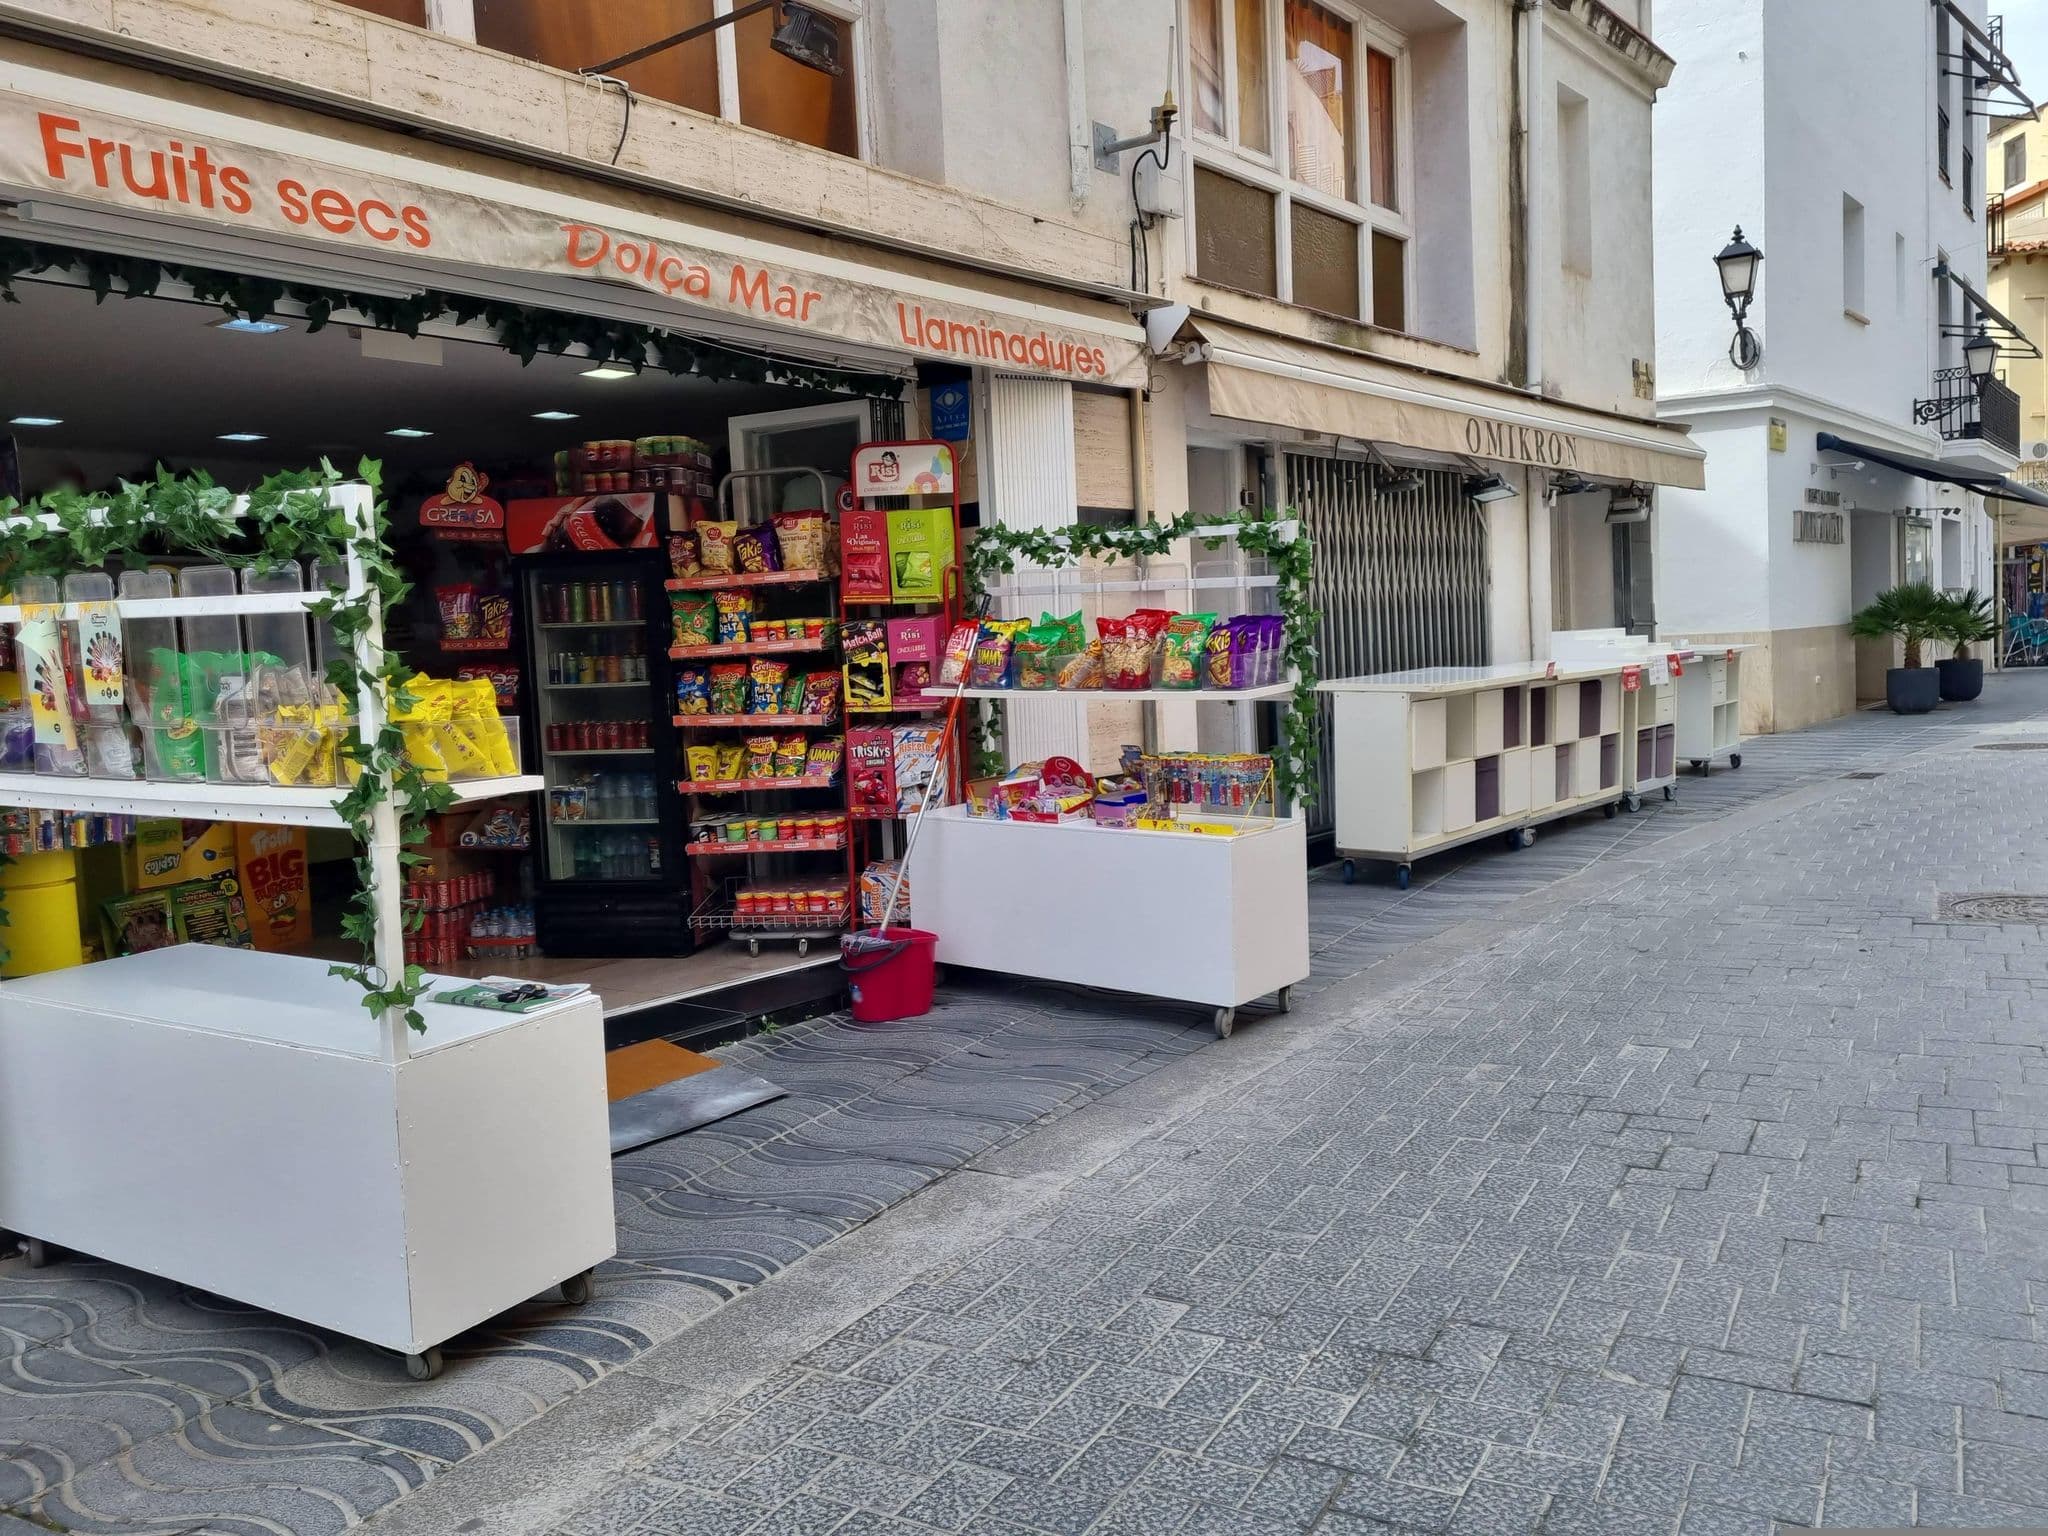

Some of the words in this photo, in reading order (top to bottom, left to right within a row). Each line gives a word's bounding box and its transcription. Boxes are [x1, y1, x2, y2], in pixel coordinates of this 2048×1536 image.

[37, 112, 253, 214] Fruits
[277, 178, 432, 249] secs
[559, 223, 712, 298] Dolça
[728, 264, 822, 322] Mar
[896, 302, 1107, 377] Llaminadures
[1464, 416, 1578, 467] OMIKRON
[869, 463, 898, 478] Risi
[900, 628, 922, 641] Risi
[246, 848, 305, 890] BIG
